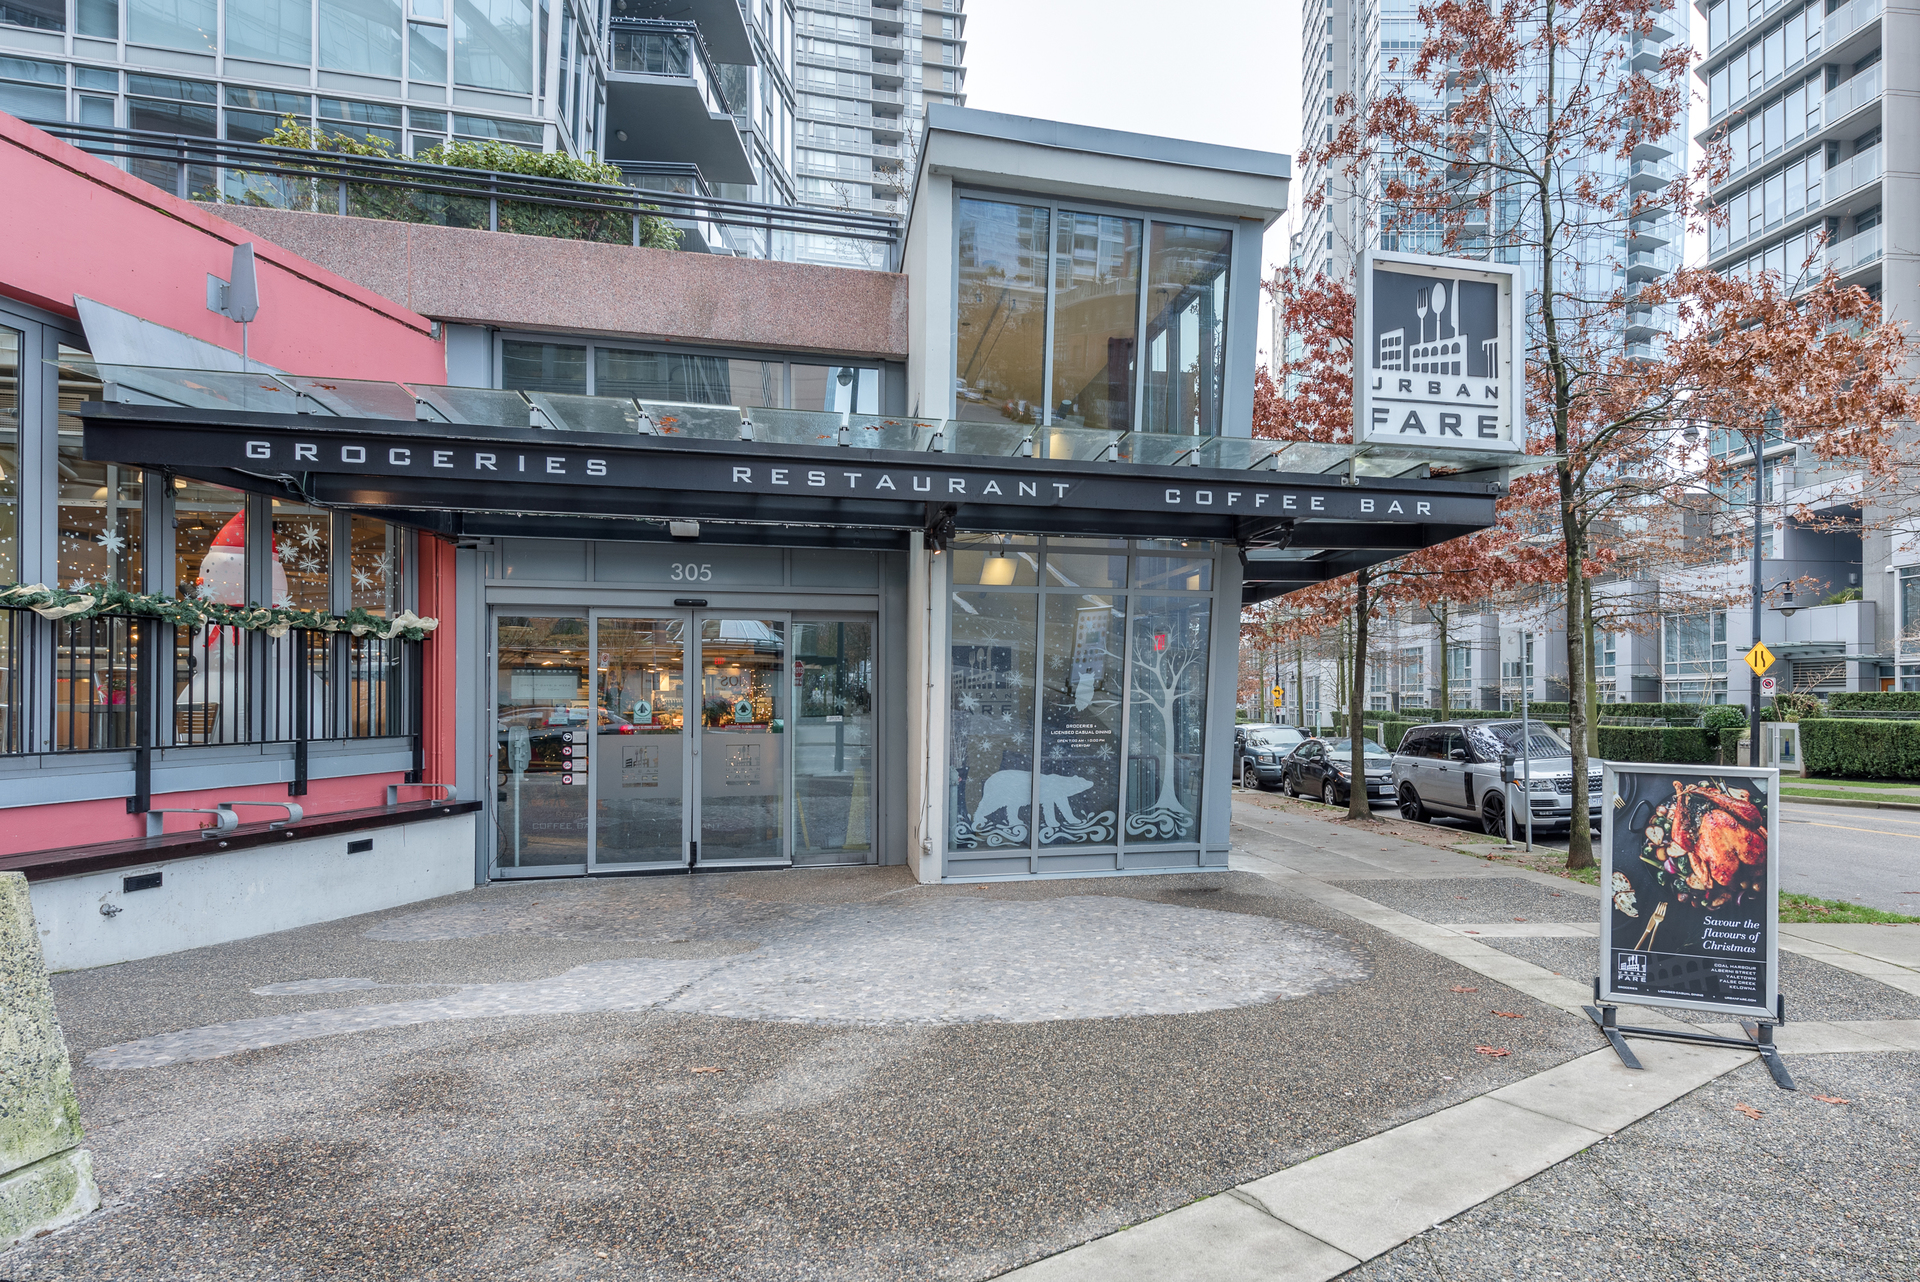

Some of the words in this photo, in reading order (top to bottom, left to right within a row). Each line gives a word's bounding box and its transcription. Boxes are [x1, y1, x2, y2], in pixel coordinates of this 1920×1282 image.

[1371, 407, 1499, 438] FARE
[245, 440, 607, 477] GROCERIES
[732, 466, 1070, 499] RESTAURANT
[1165, 488, 1325, 511] COFFEE
[1360, 498, 1431, 516] BAR
[670, 562, 712, 581] 305
[1702, 915, 1742, 928] Savour
[1743, 918, 1760, 929] the
[1701, 927, 1747, 940] flavours
[1748, 931, 1761, 944] of
[1702, 940, 1757, 954] Christmas
[1617, 975, 1647, 983] FARE
